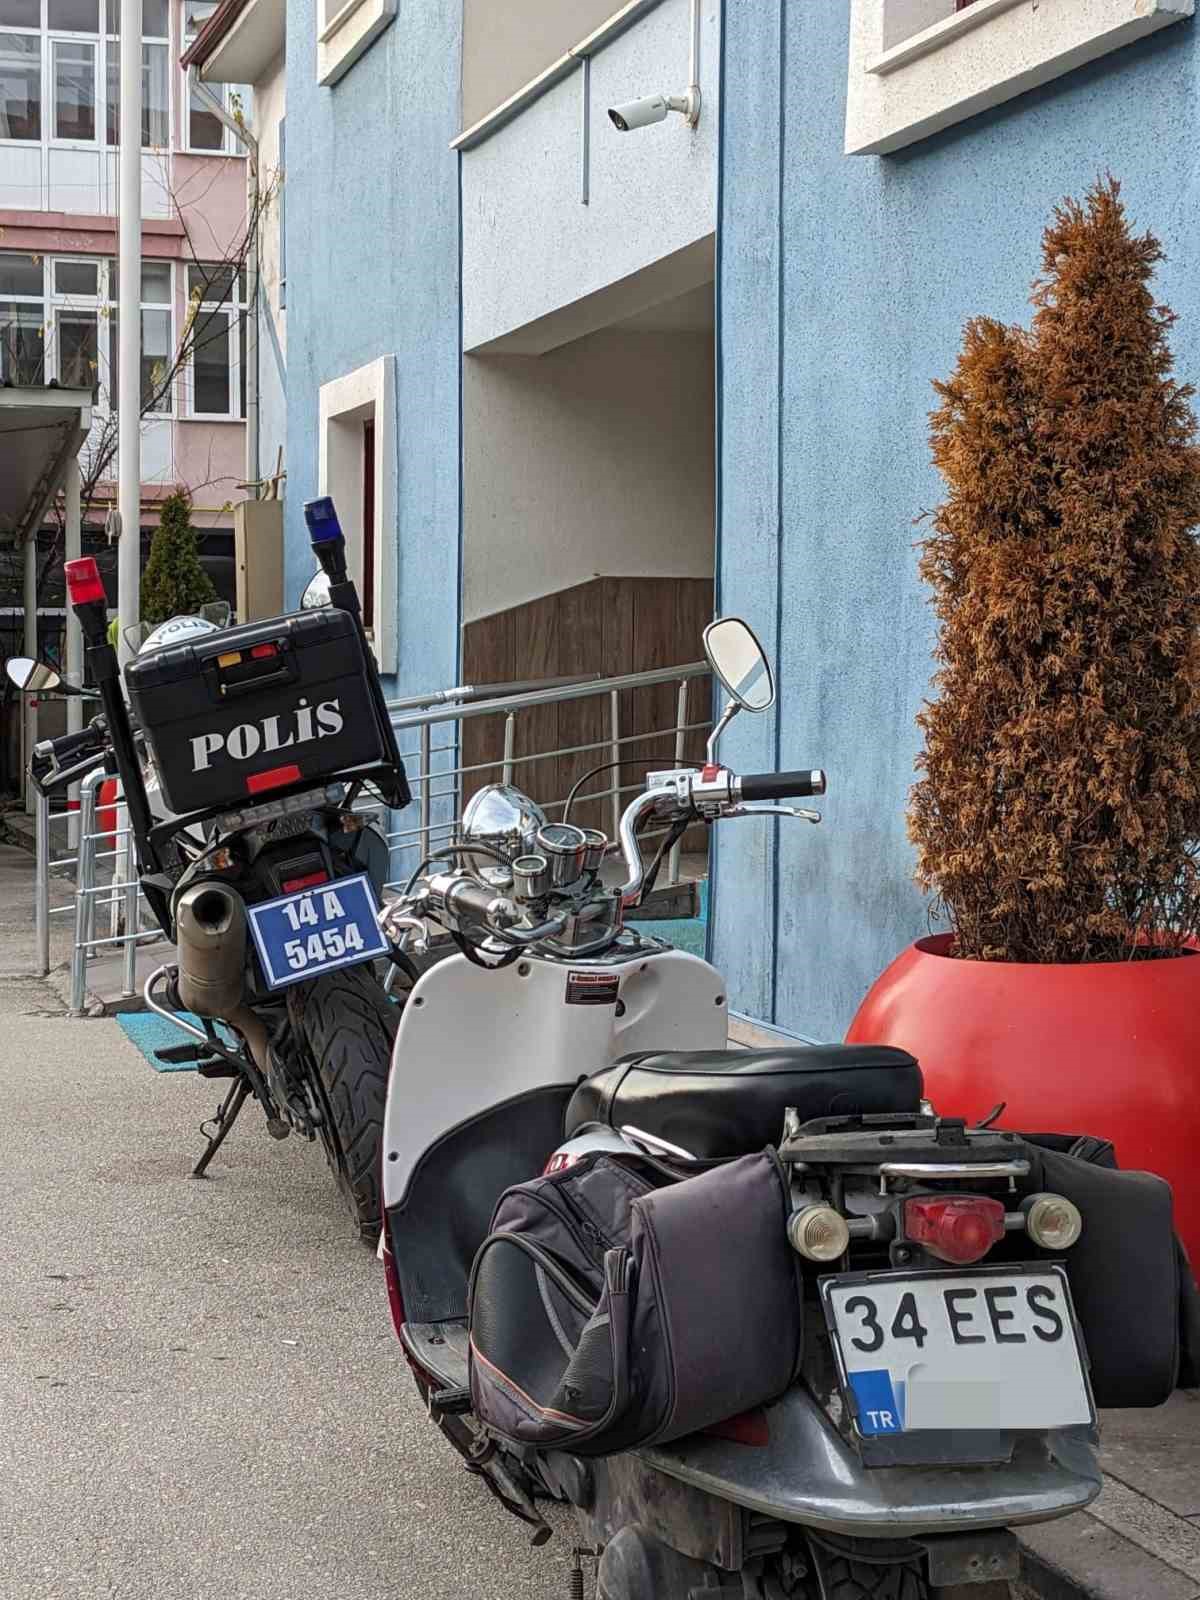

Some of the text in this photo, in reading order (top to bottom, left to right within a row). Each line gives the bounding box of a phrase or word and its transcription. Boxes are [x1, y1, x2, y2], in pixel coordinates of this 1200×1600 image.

[189, 698, 344, 772] POLİS
[281, 891, 346, 931] 14 A
[284, 923, 365, 970] 5454
[844, 1284, 1063, 1353] 34 EES
[867, 1411, 895, 1429] TR
